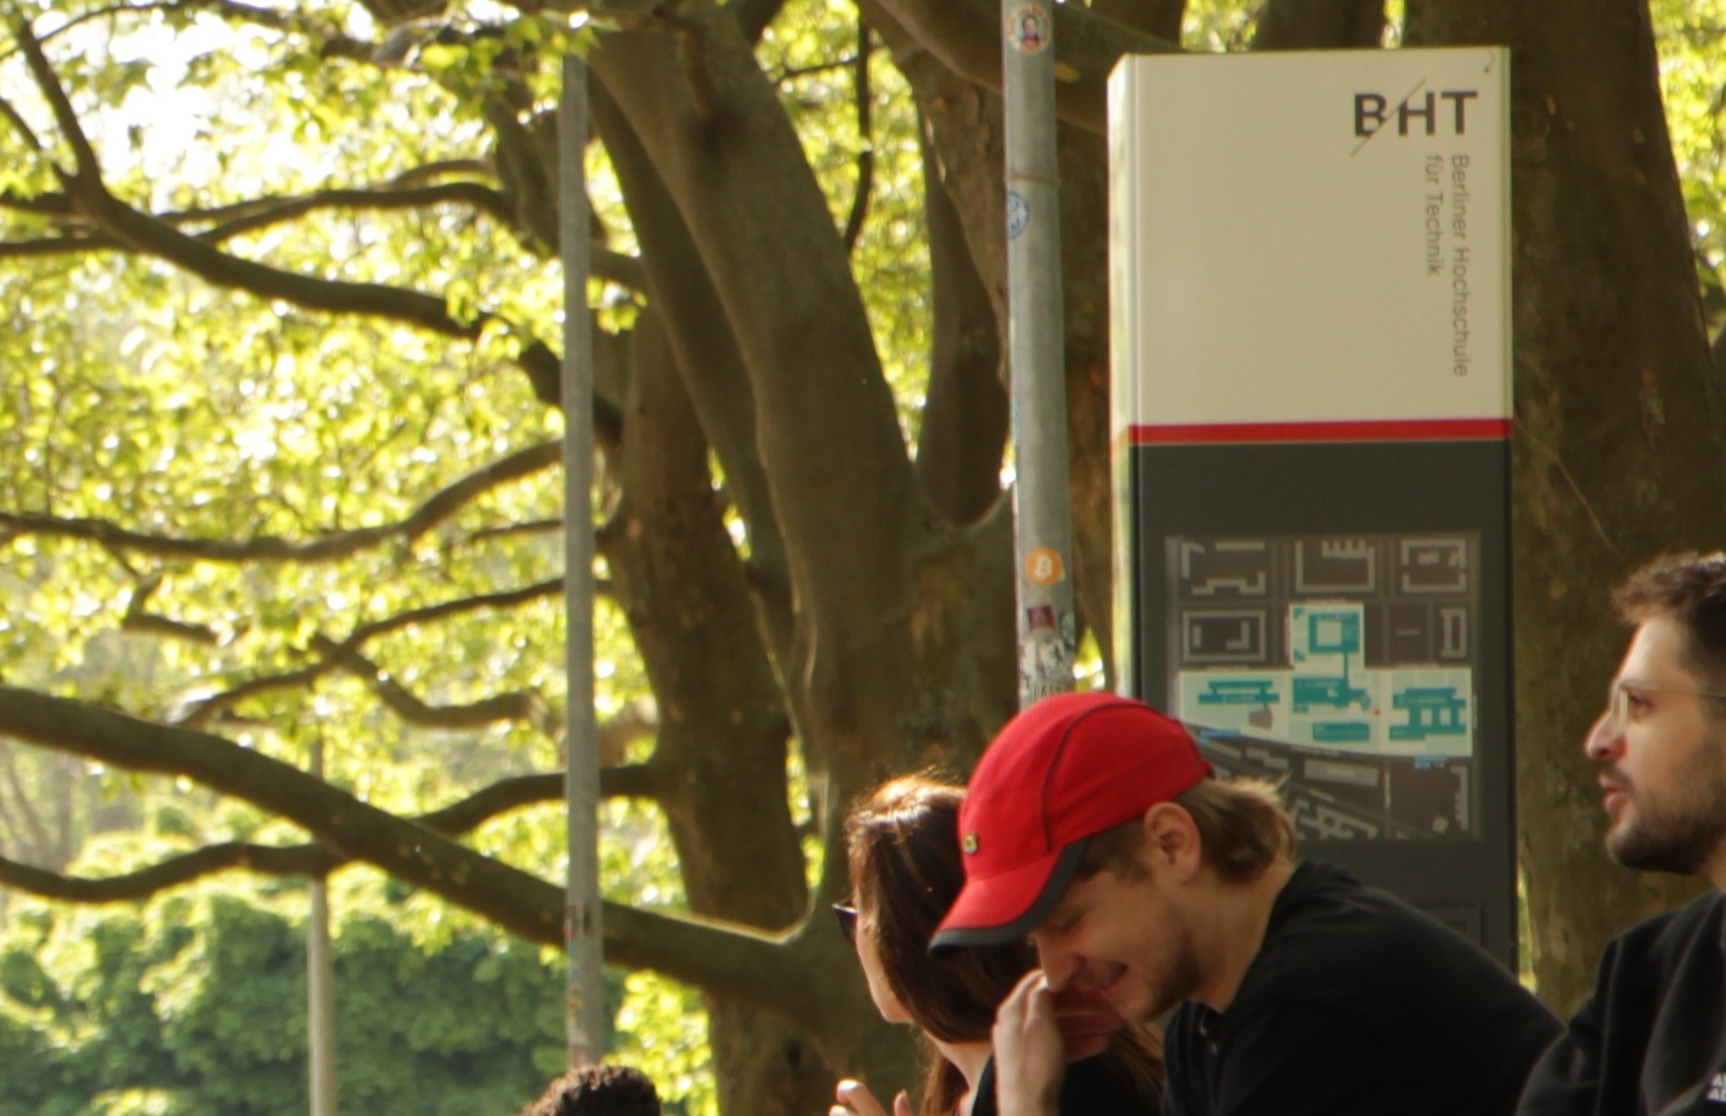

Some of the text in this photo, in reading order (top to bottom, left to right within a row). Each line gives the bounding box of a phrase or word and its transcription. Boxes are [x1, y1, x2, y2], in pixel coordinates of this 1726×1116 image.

[1353, 90, 1479, 137] BHT
[1425, 154, 1444, 277] für Technik
[1451, 153, 1471, 378] Berliner Hochschule
